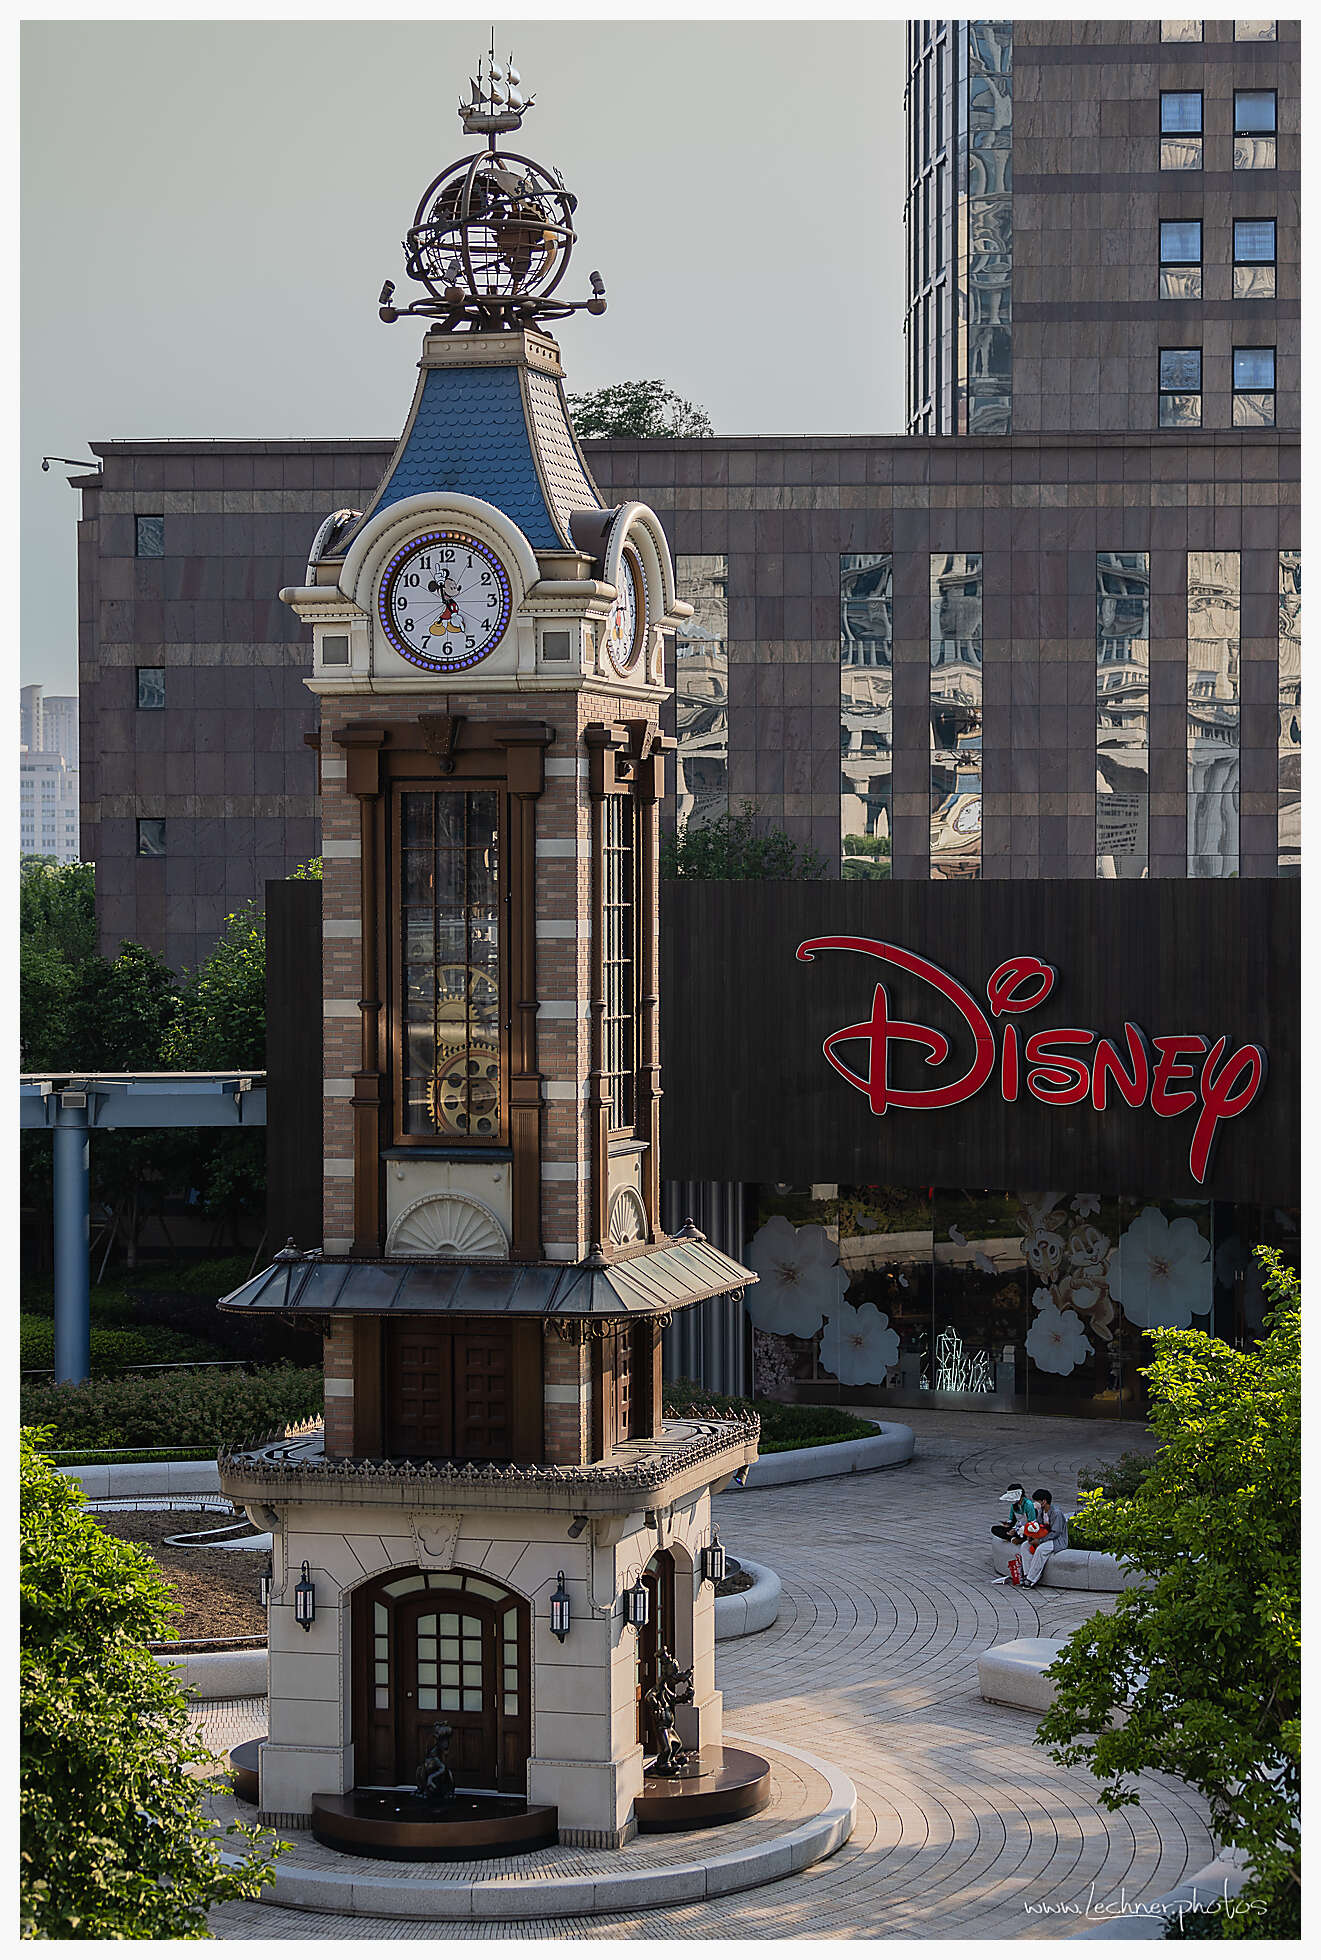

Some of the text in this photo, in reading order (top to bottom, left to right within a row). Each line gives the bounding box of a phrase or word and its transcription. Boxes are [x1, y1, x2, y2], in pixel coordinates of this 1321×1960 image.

[419, 556, 431, 569] 11
[439, 549, 456, 563] 12
[466, 554, 473, 568] 1
[403, 573, 420, 588] 10
[480, 572, 492, 586] 2
[397, 597, 407, 610] 9
[487, 594, 497, 607] 3
[404, 619, 414, 632] 8
[481, 618, 491, 631] 4
[421, 635, 431, 649] 7
[442, 642, 453, 655] 6
[465, 635, 476, 649] 5
